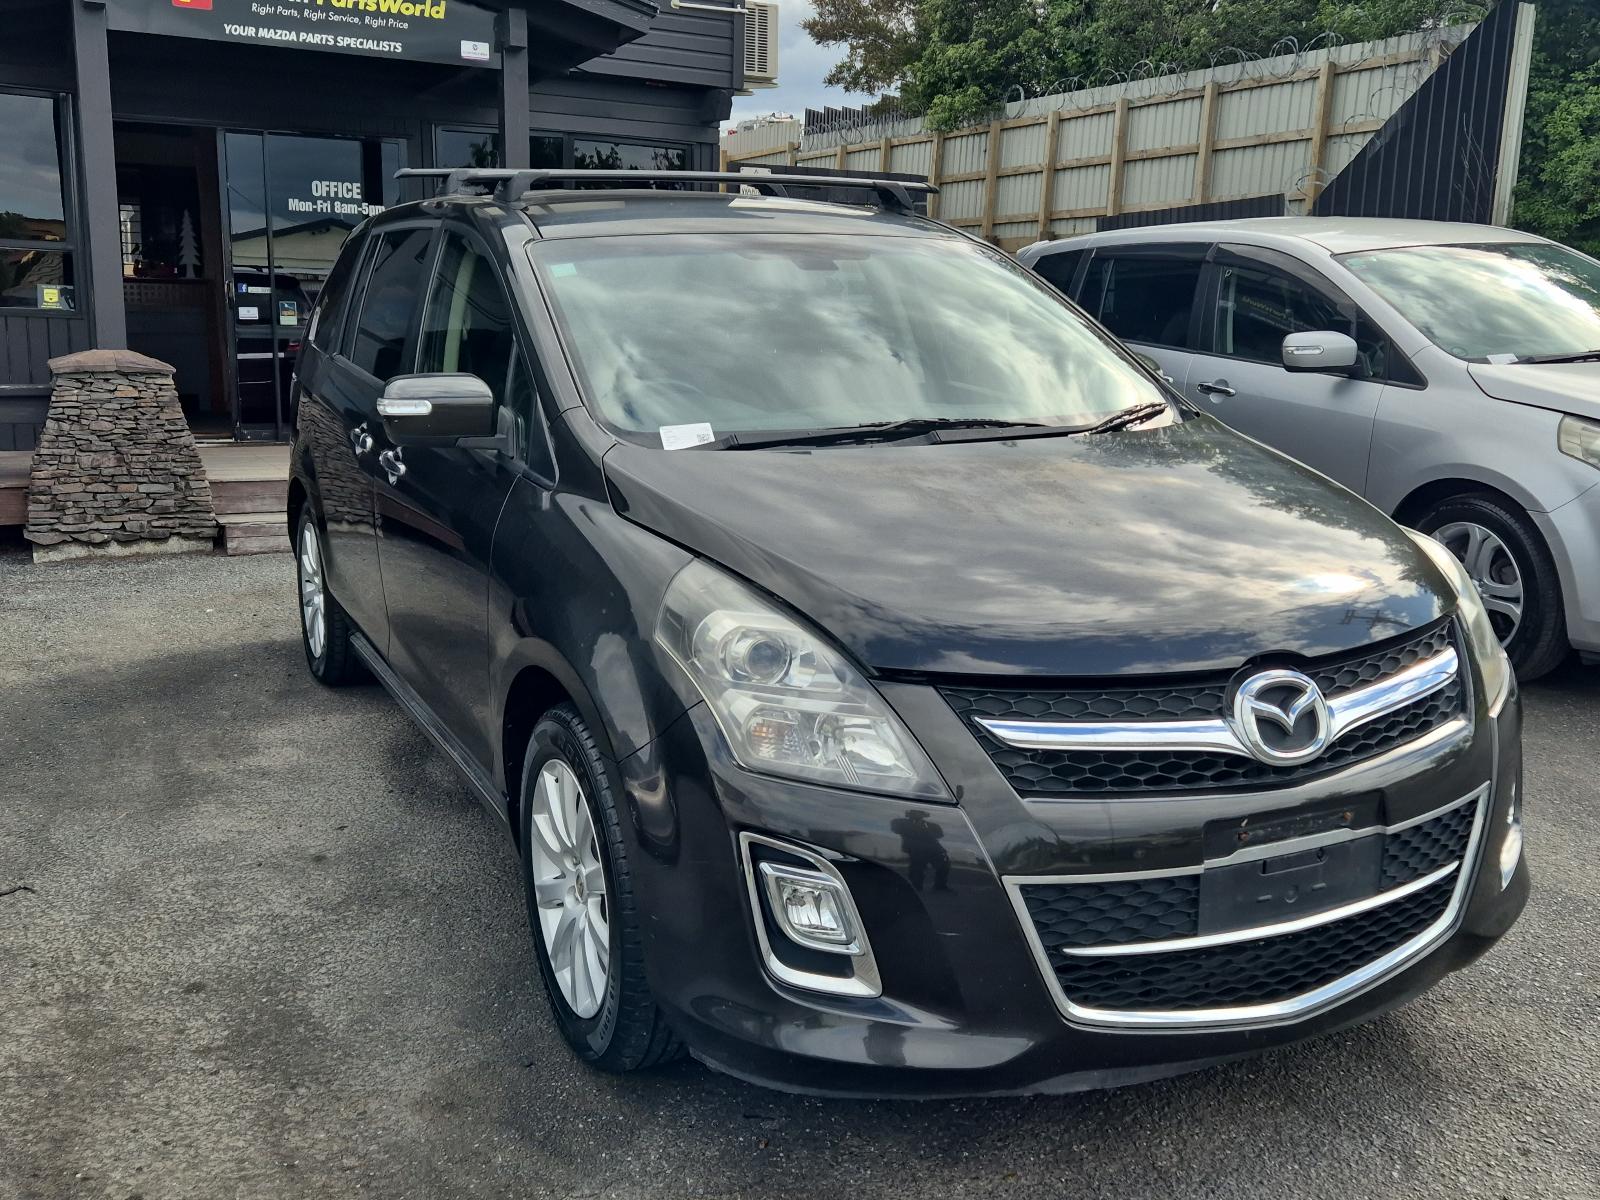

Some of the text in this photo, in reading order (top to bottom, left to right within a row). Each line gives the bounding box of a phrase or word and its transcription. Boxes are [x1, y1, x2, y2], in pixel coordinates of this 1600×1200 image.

[251, 3, 409, 29] Right Parts, Right Service, Right Price
[316, 0, 446, 19] artsWorld
[223, 23, 403, 53] YOUR MAZDA PARTS SPECIALISTS
[311, 180, 362, 199] OFFICE
[288, 198, 331, 213] Mon-Fri
